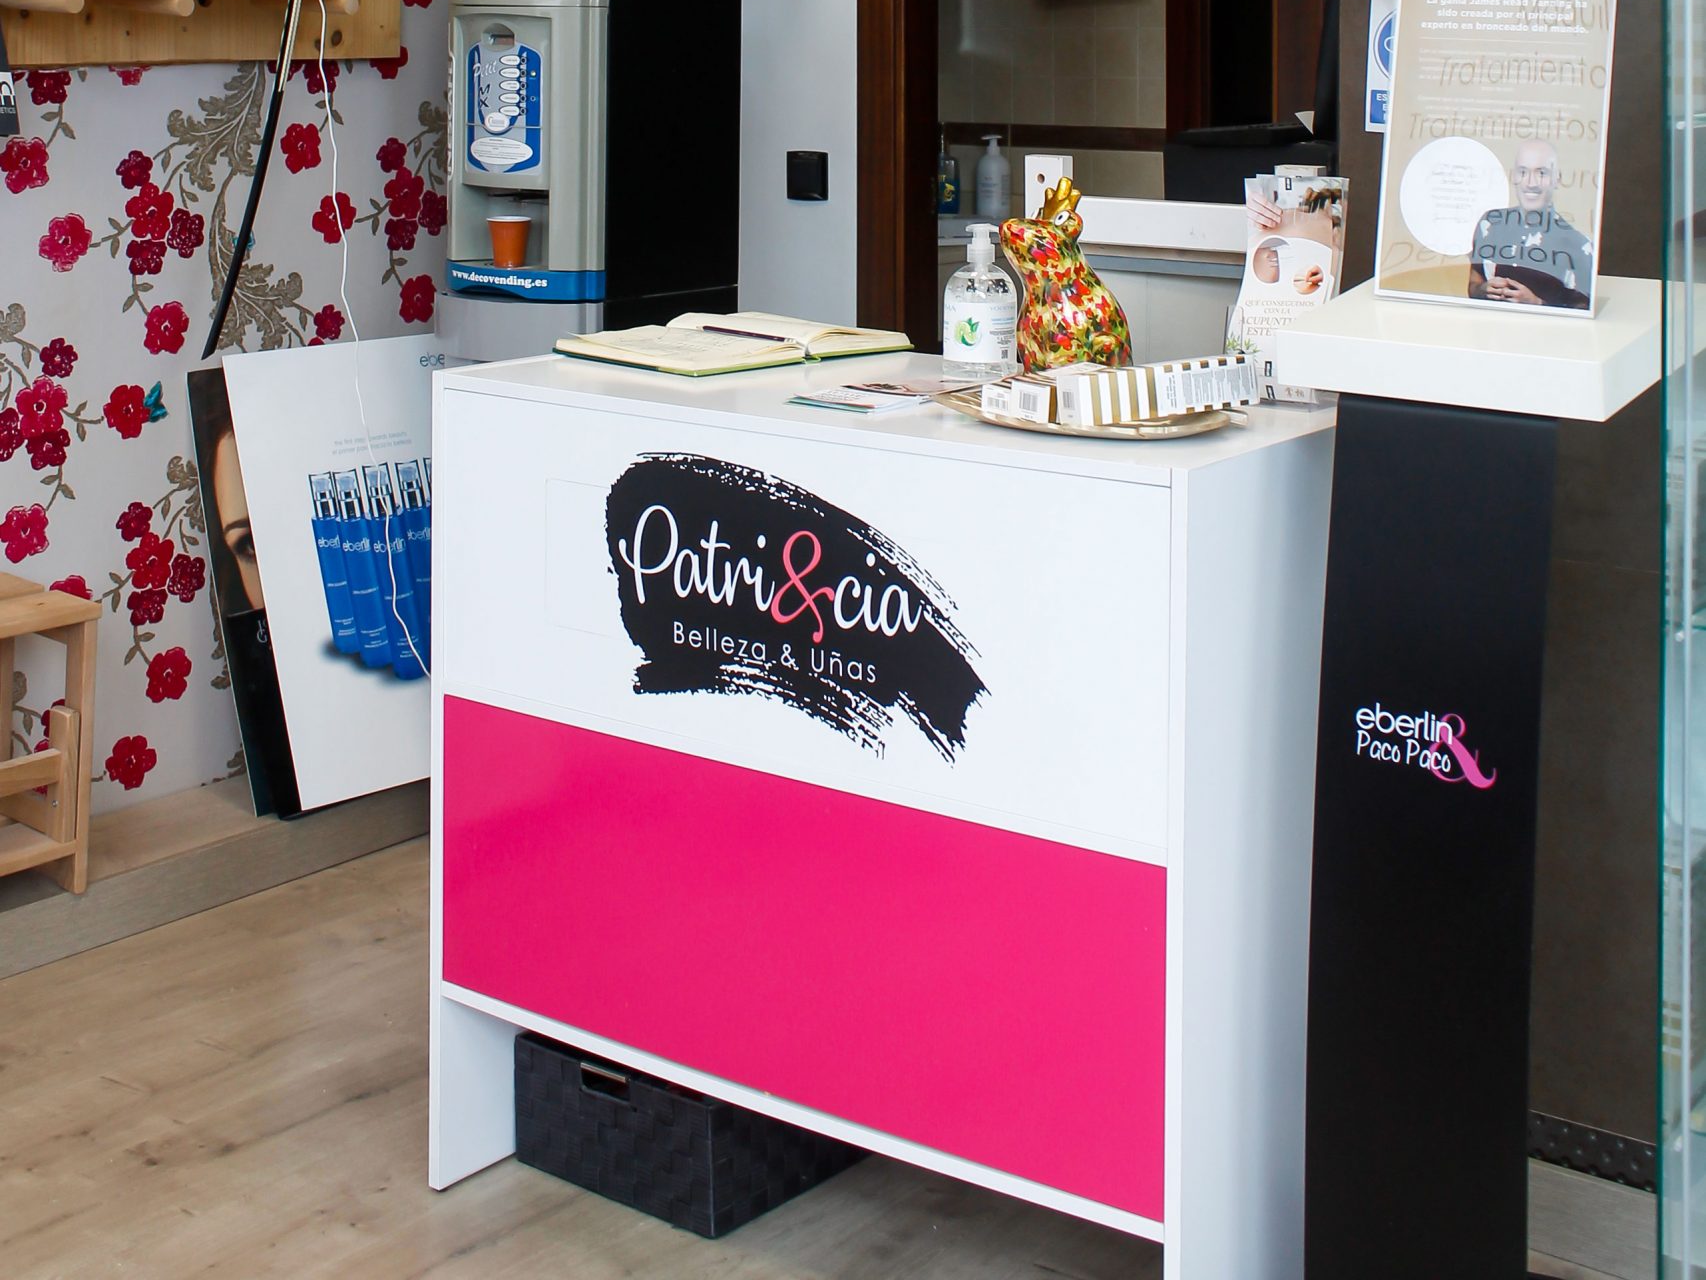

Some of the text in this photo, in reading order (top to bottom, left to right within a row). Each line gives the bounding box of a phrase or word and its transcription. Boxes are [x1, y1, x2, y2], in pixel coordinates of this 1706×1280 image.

[1574, 0, 1588, 8] ha
[1437, 8, 1573, 22] sido creada por el principal
[1421, 22, 1590, 34] experto en bronceado del mundo.
[452, 270, 547, 288] www.decovending.es
[673, 621, 877, 683] Belleza & Uñas
[1356, 702, 1453, 745] eberlin
[1357, 730, 1451, 773] Paco Paco
